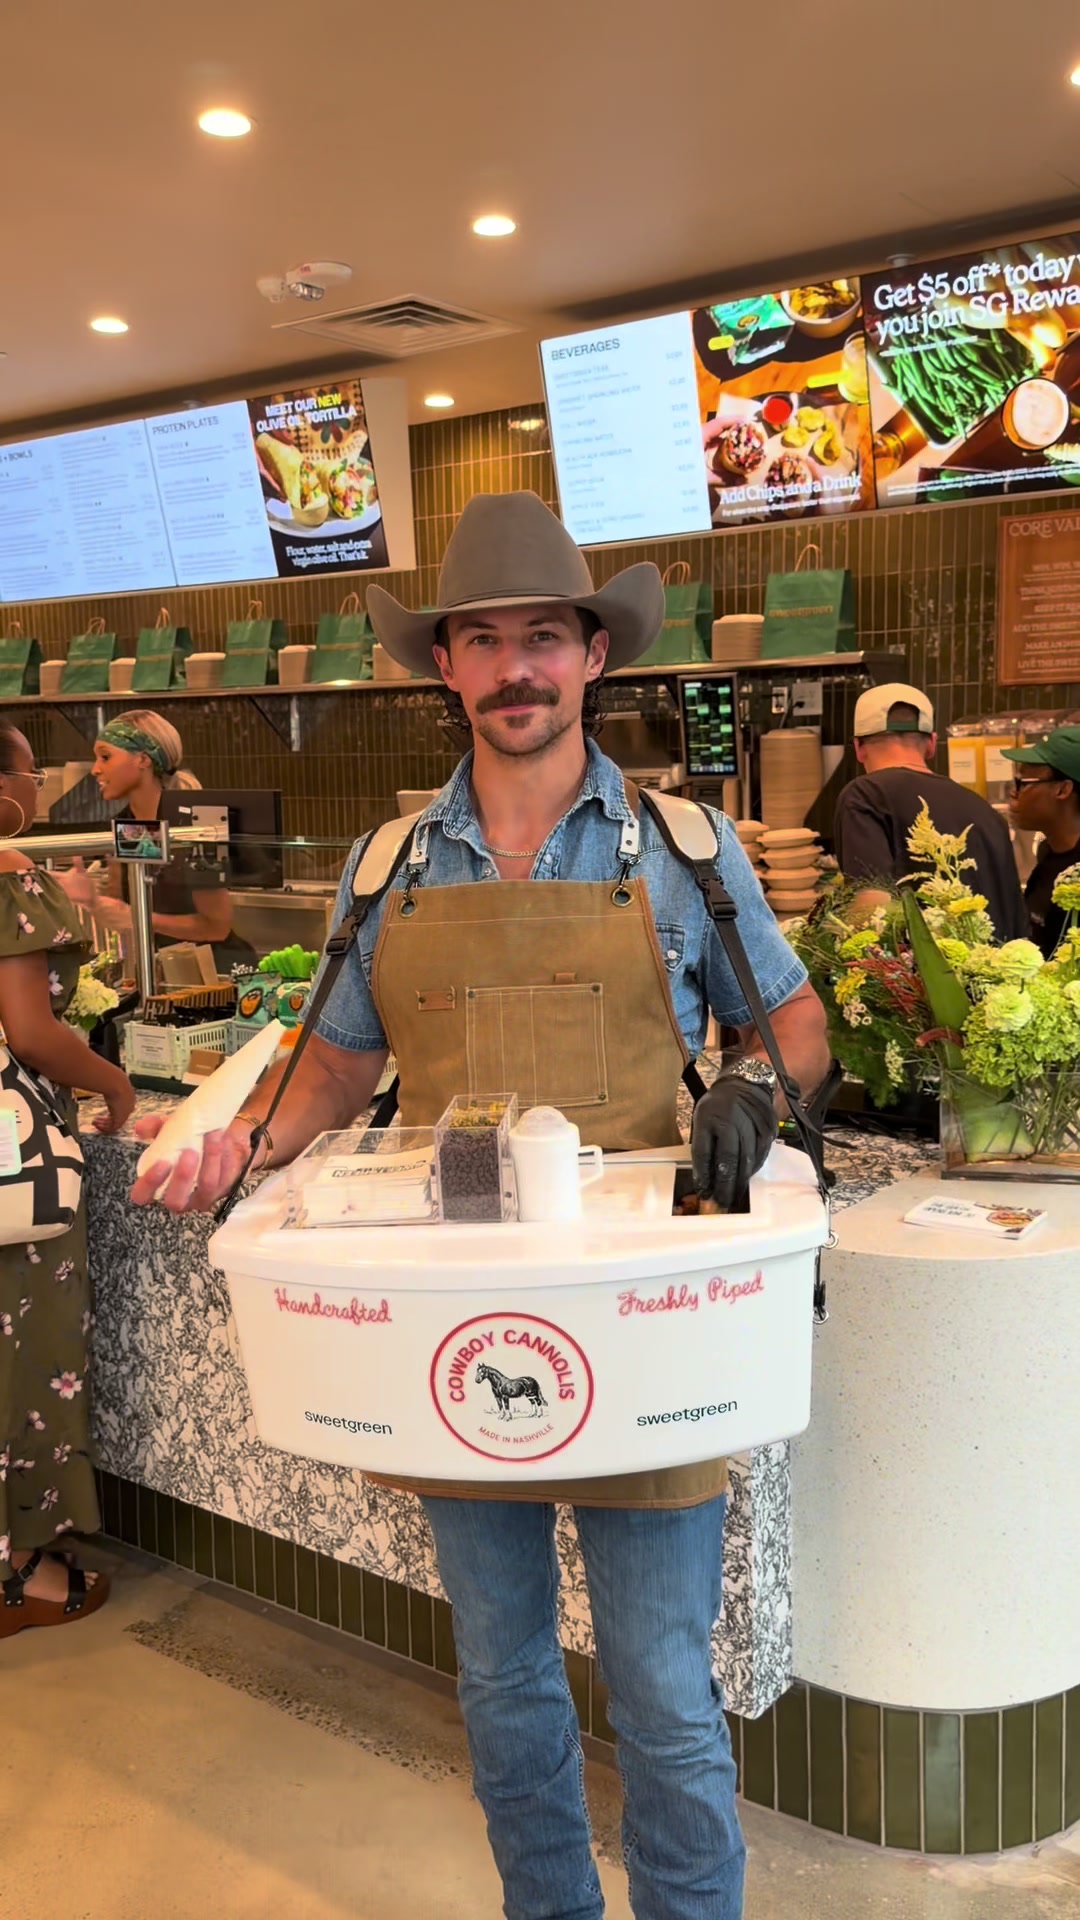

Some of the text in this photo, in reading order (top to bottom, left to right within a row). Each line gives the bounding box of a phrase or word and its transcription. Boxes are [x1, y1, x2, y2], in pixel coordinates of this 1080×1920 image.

[874, 283, 916, 310] Get
[918, 272, 950, 304] $5
[1003, 252, 1072, 287] today
[875, 313, 920, 345] you
[921, 302, 965, 337] join
[969, 292, 1008, 321] SG
[551, 338, 621, 361] BEVERAGES
[256, 416, 287, 432] OLIVE
[305, 405, 358, 424] TORTILLA
[265, 393, 342, 417] MEET OUR NEW
[152, 416, 219, 435] PROTEIN PLATES
[720, 489, 746, 504] Add
[746, 483, 784, 502] Chips
[785, 480, 812, 496] and
[822, 471, 862, 490] Drink
[1008, 519, 1054, 538] CORE
[274, 1287, 393, 1325] Handcrafted
[617, 1269, 764, 1316] Freshly Piped
[448, 1329, 575, 1403] COWBOY CANNOLIS
[304, 1410, 393, 1435] sweetgreen
[636, 1400, 738, 1427] sweetgreen
[478, 1426, 500, 1441] MADE
[513, 1423, 555, 1444] NASHVILLE
